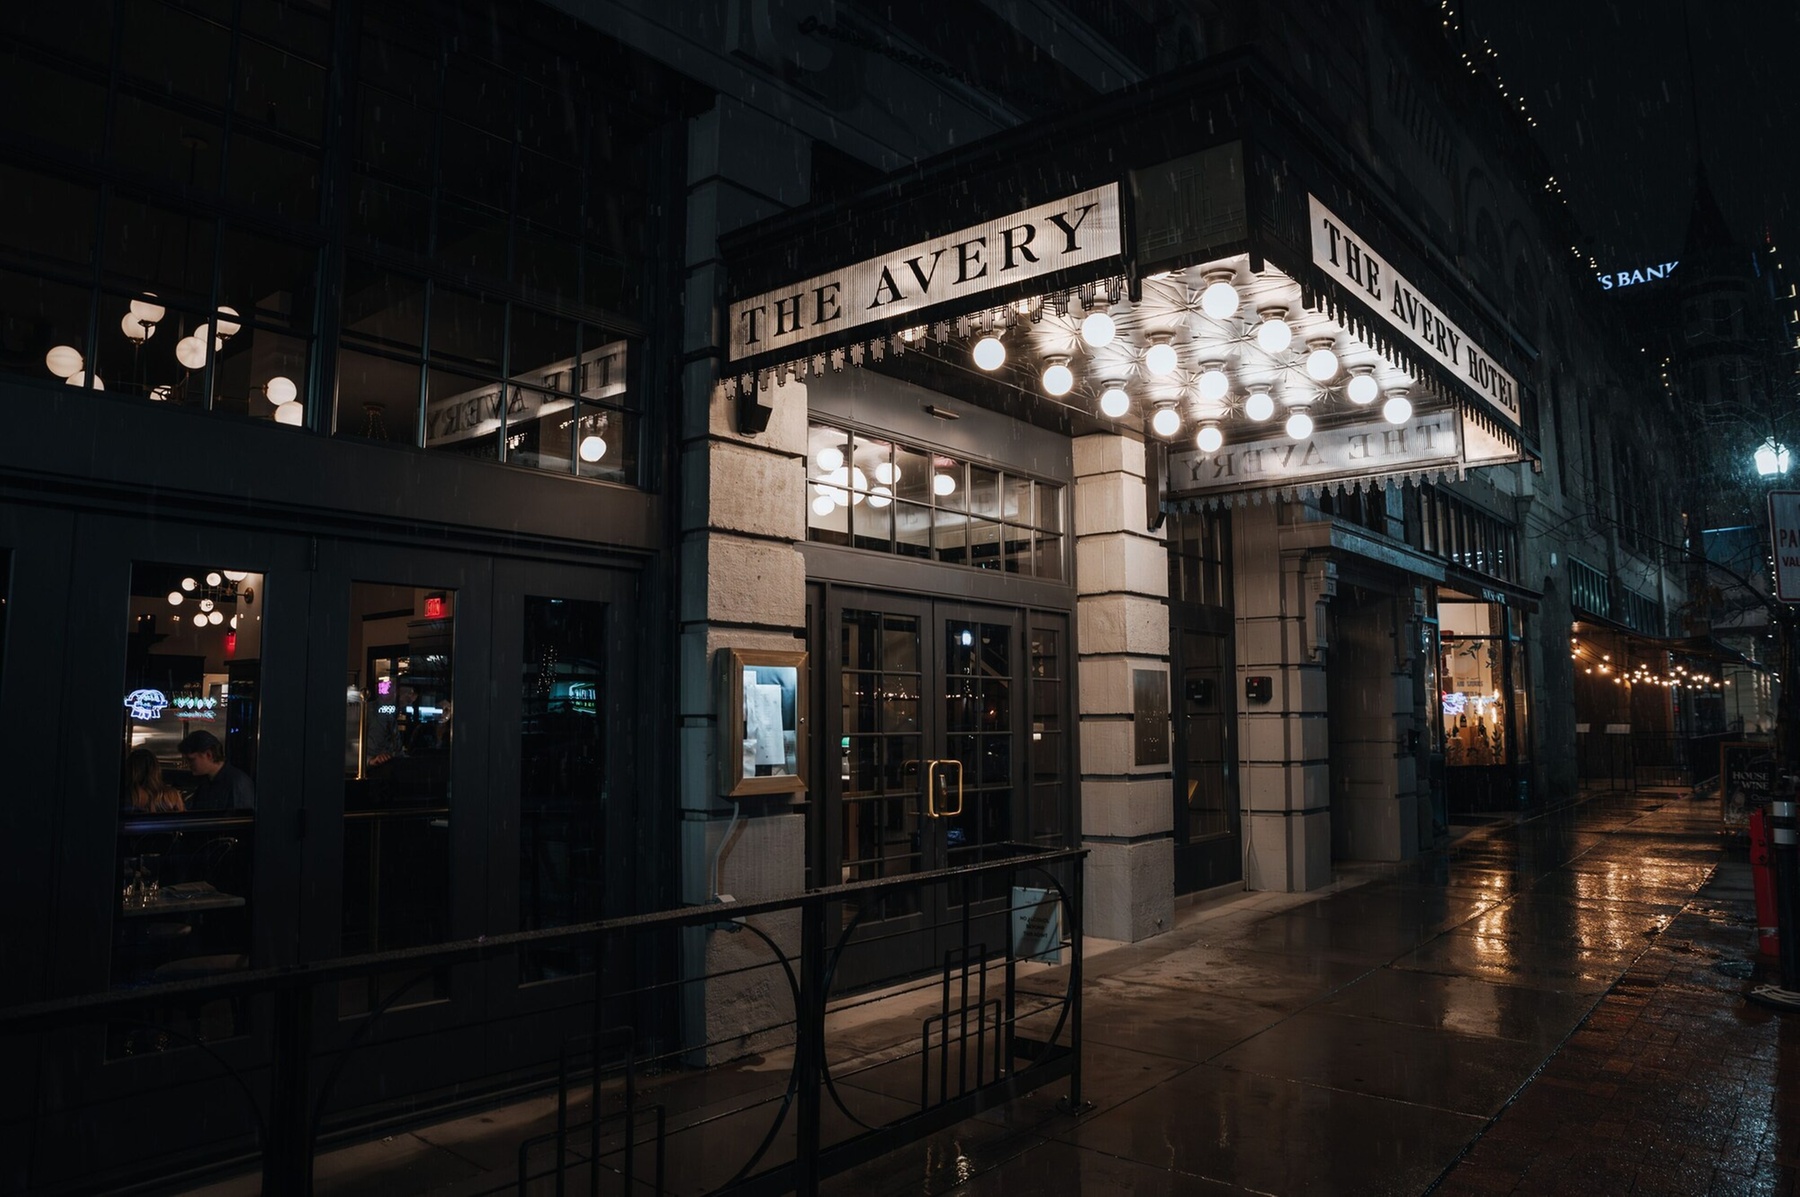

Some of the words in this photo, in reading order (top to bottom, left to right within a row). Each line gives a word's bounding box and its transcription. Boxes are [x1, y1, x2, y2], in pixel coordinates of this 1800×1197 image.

[741, 281, 842, 346] THE
[866, 202, 1099, 311] AVERY
[1597, 274, 1613, 290] S
[1323, 218, 1382, 302] THE
[1390, 279, 1462, 366] AVERY
[1466, 344, 1518, 415] HOTEL
[1780, 529, 1800, 548] PA
[1732, 771, 1769, 781] HOUSE
[1741, 781, 1769, 790] WINE
